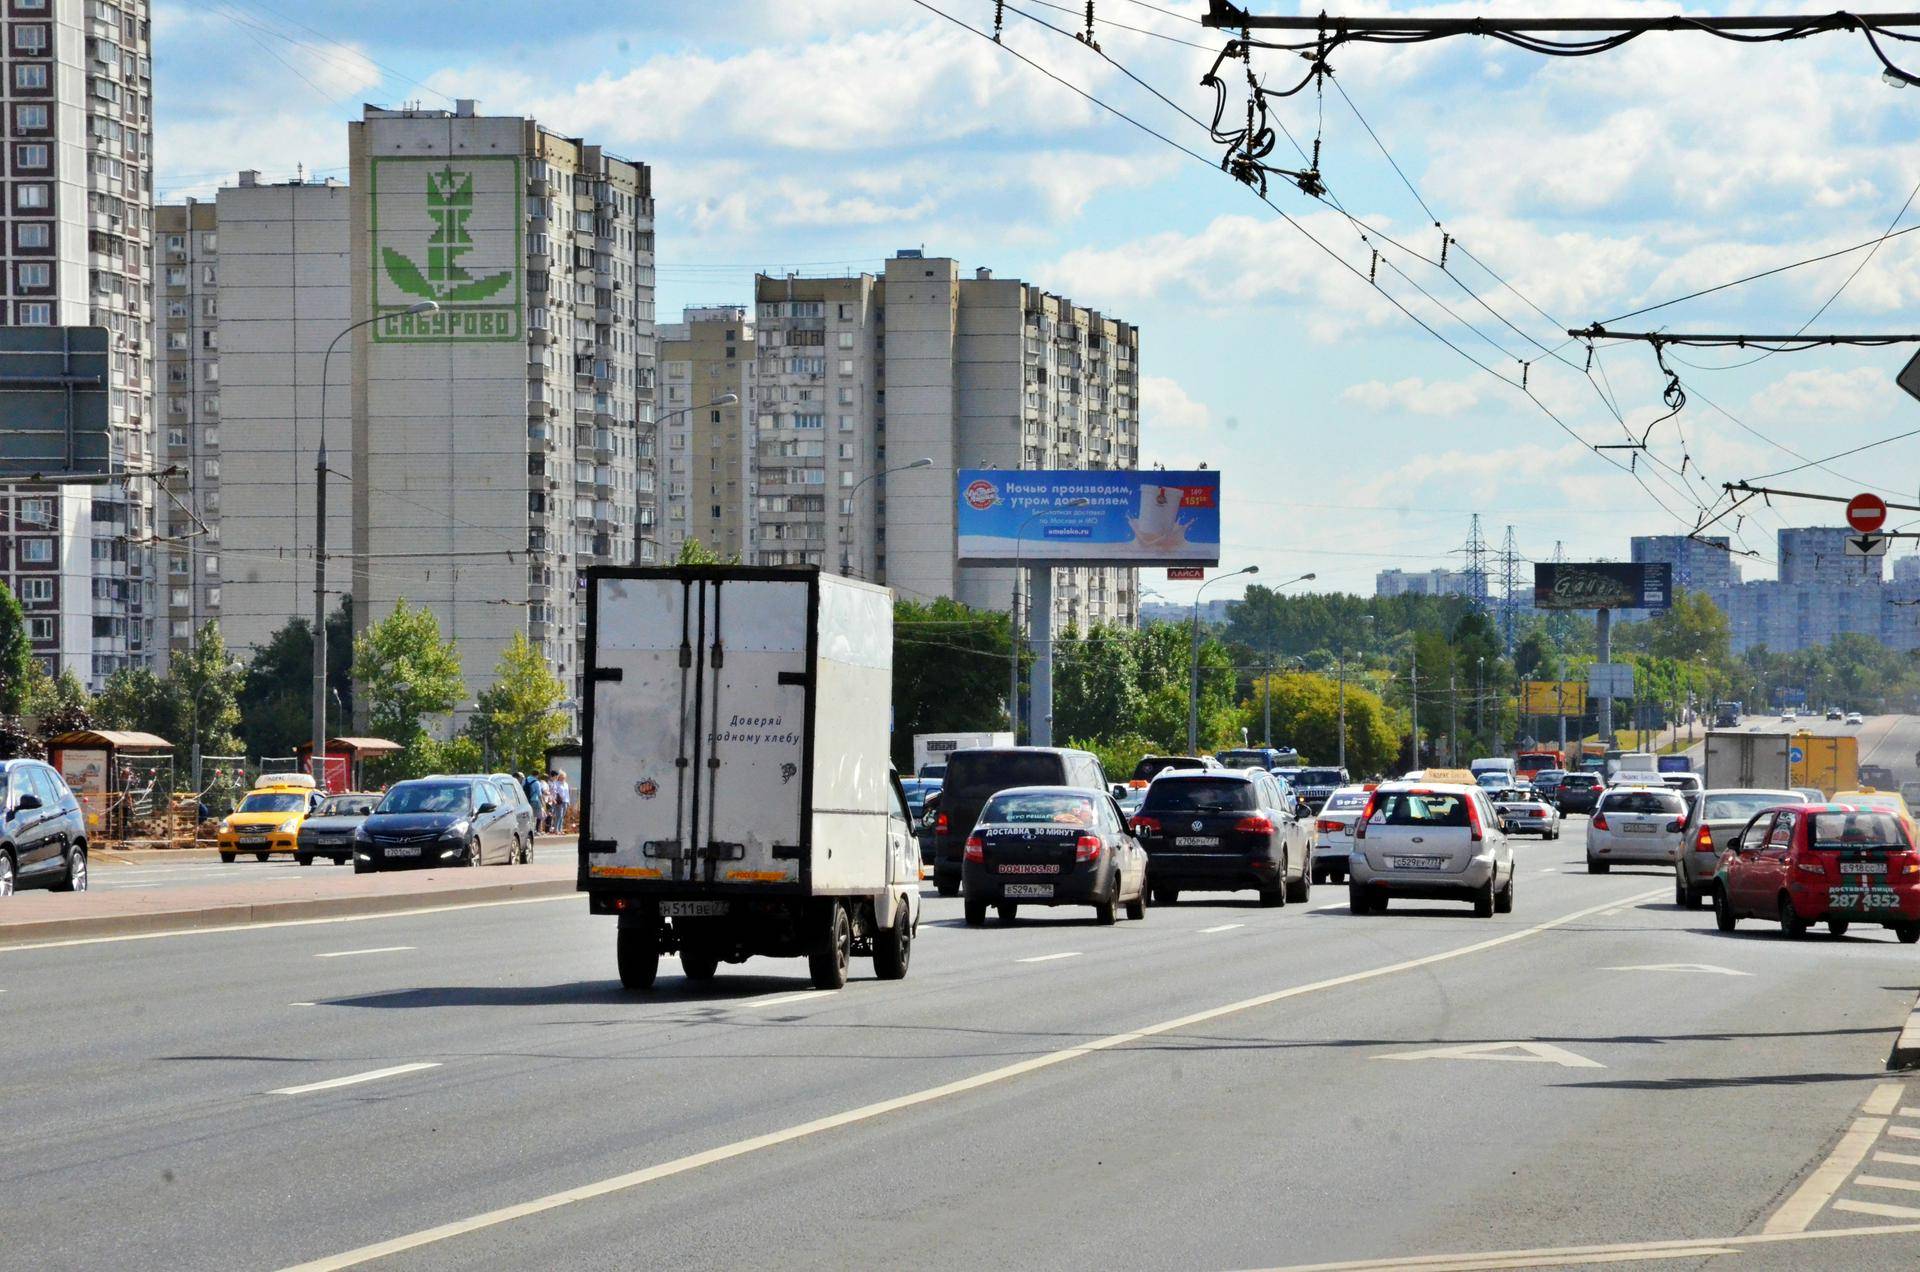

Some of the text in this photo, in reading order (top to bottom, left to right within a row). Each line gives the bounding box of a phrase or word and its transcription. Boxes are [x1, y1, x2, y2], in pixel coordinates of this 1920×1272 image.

[386, 312, 509, 335] САБУРОВО
[1006, 482, 1133, 496] Ночью производим,
[1011, 497, 1050, 508] утром
[730, 715, 783, 727] Доверяй
[708, 732, 800, 745] родному хлебу
[986, 828, 1030, 836] ДОСТАВКА
[999, 865, 1060, 873] DOMINOS.RU
[1829, 895, 1900, 907] 287 4352
